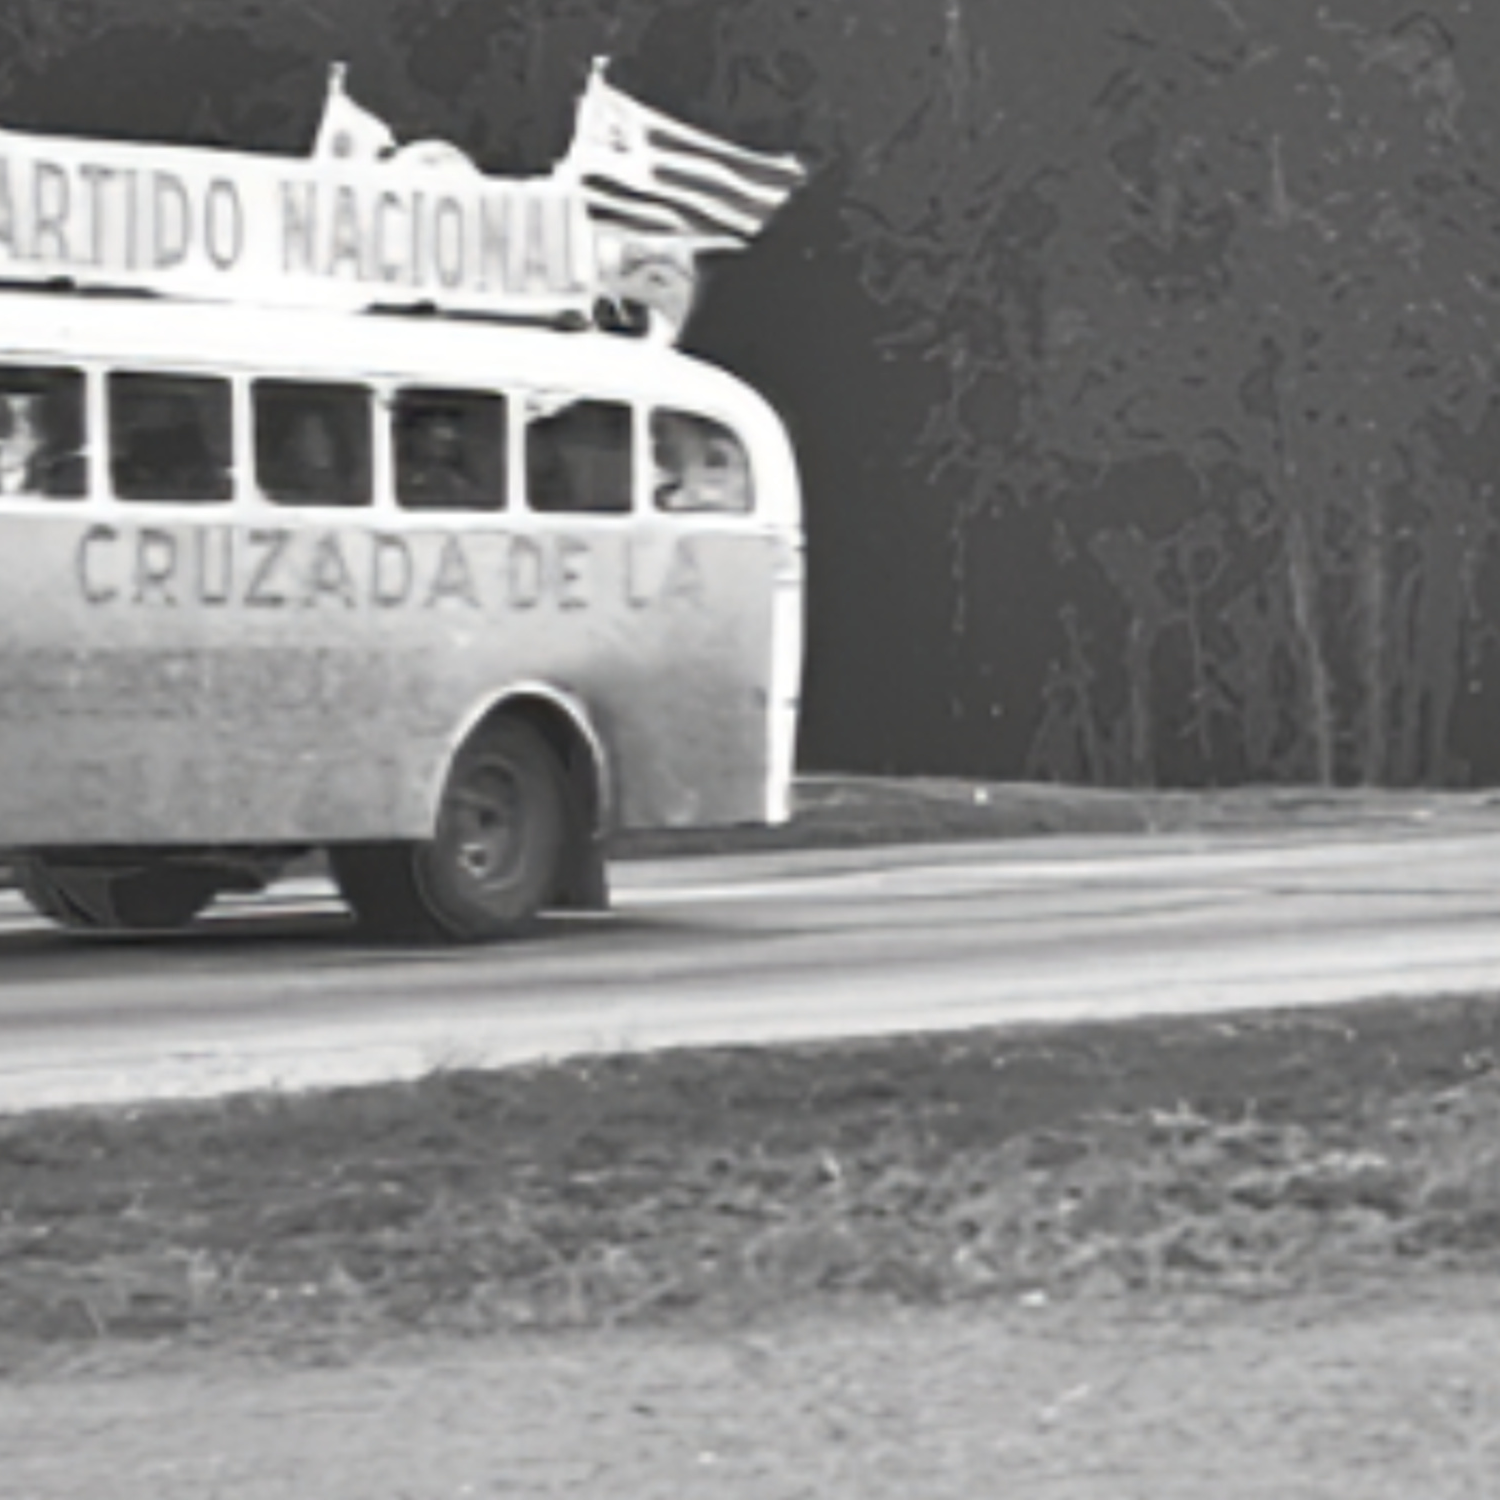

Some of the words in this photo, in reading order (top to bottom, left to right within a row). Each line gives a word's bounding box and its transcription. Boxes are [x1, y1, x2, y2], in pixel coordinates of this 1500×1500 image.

[278, 178, 590, 292] NACIONAL
[76, 523, 480, 609] CRUZADA
[507, 534, 591, 611] DE
[620, 536, 703, 610] LA
